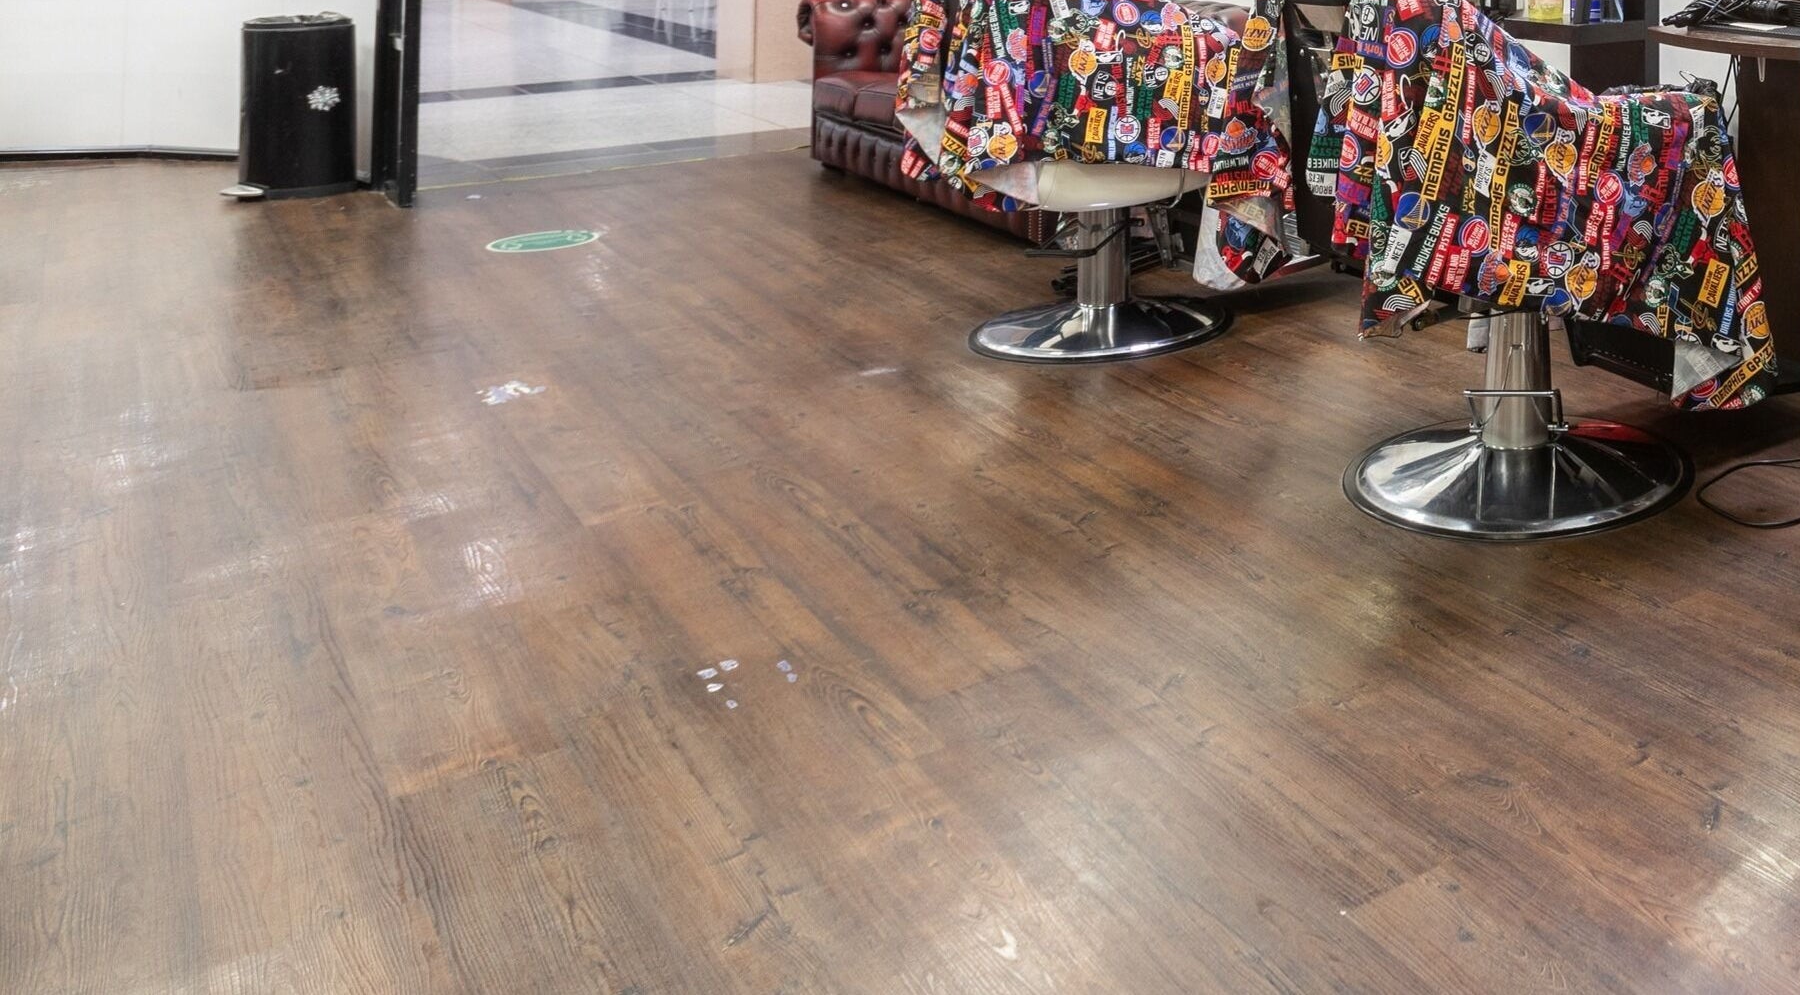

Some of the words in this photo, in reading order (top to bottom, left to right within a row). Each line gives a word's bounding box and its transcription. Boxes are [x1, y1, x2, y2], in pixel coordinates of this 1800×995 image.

[1183, 26, 1193, 77] GRIZZLIES
[1464, 32, 1477, 67] NETS
[1092, 72, 1109, 99] NETS
[1135, 56, 1146, 86] JAZZ
[1144, 63, 1157, 88] NETS
[1467, 69, 1476, 105] PISTONS
[1179, 79, 1192, 129] MEMPHIS
[1422, 127, 1451, 201] MEMPHIS
[1443, 46, 1464, 122] GRIZZLIES
[1462, 106, 1473, 140] DETROIT
[1582, 125, 1596, 158] PISTONS
[1587, 124, 1613, 188] MEMPHIS
[1615, 124, 1632, 172] MILWAUKEE
[1578, 157, 1588, 191] DETROIT
[1434, 204, 1450, 238] BUCKS
[1489, 183, 1505, 250] MEMPHIS
[1583, 202, 1600, 243] CHICAGO
[1602, 204, 1614, 236] PISTONS
[1391, 241, 1406, 262] NETS
[1438, 217, 1457, 253] PISTONS
[1601, 236, 1610, 271] DETROIT
[1706, 264, 1728, 304] CAVALIERS
[1719, 306, 1734, 335] DALLAS
[1709, 365, 1747, 407] MEMPHIS
